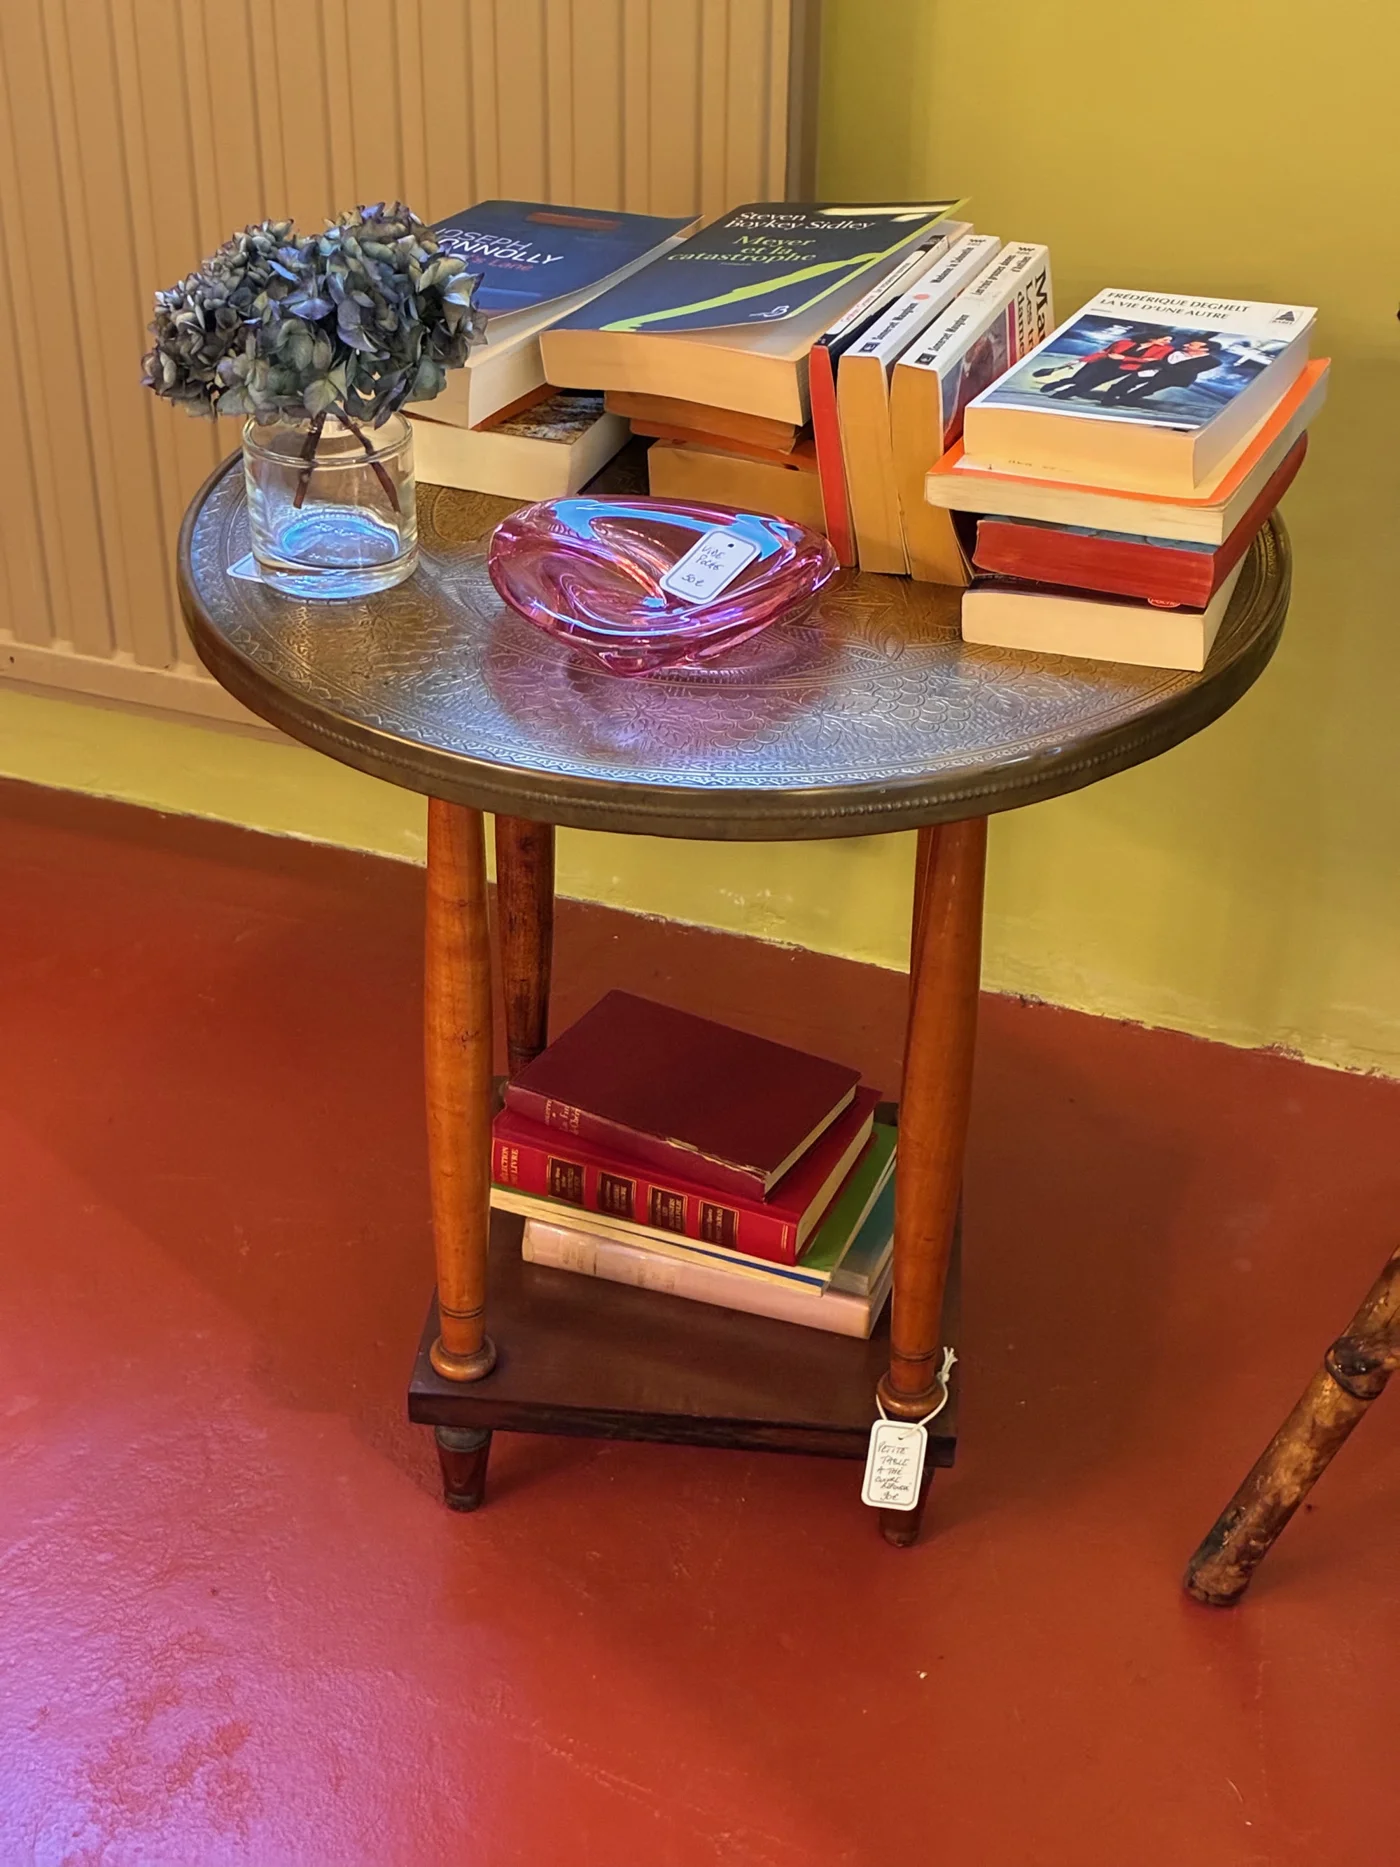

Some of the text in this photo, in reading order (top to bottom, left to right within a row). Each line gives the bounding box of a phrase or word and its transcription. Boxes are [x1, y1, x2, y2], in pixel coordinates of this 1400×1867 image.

[735, 211, 806, 221] Steven
[804, 220, 876, 230] Sidley
[733, 236, 816, 246] Meyer
[741, 246, 793, 254] et la
[668, 253, 816, 264] catastrophe
[1107, 292, 1249, 312] FRÉDÉRIQUE DEGHELT
[1141, 304, 1184, 314] D'UNE
[1186, 310, 1229, 320] AUTRE
[872, 322, 899, 340] Somerset
[928, 314, 970, 352] Somerset Maugham
[880, 1456, 910, 1466] TABLE
